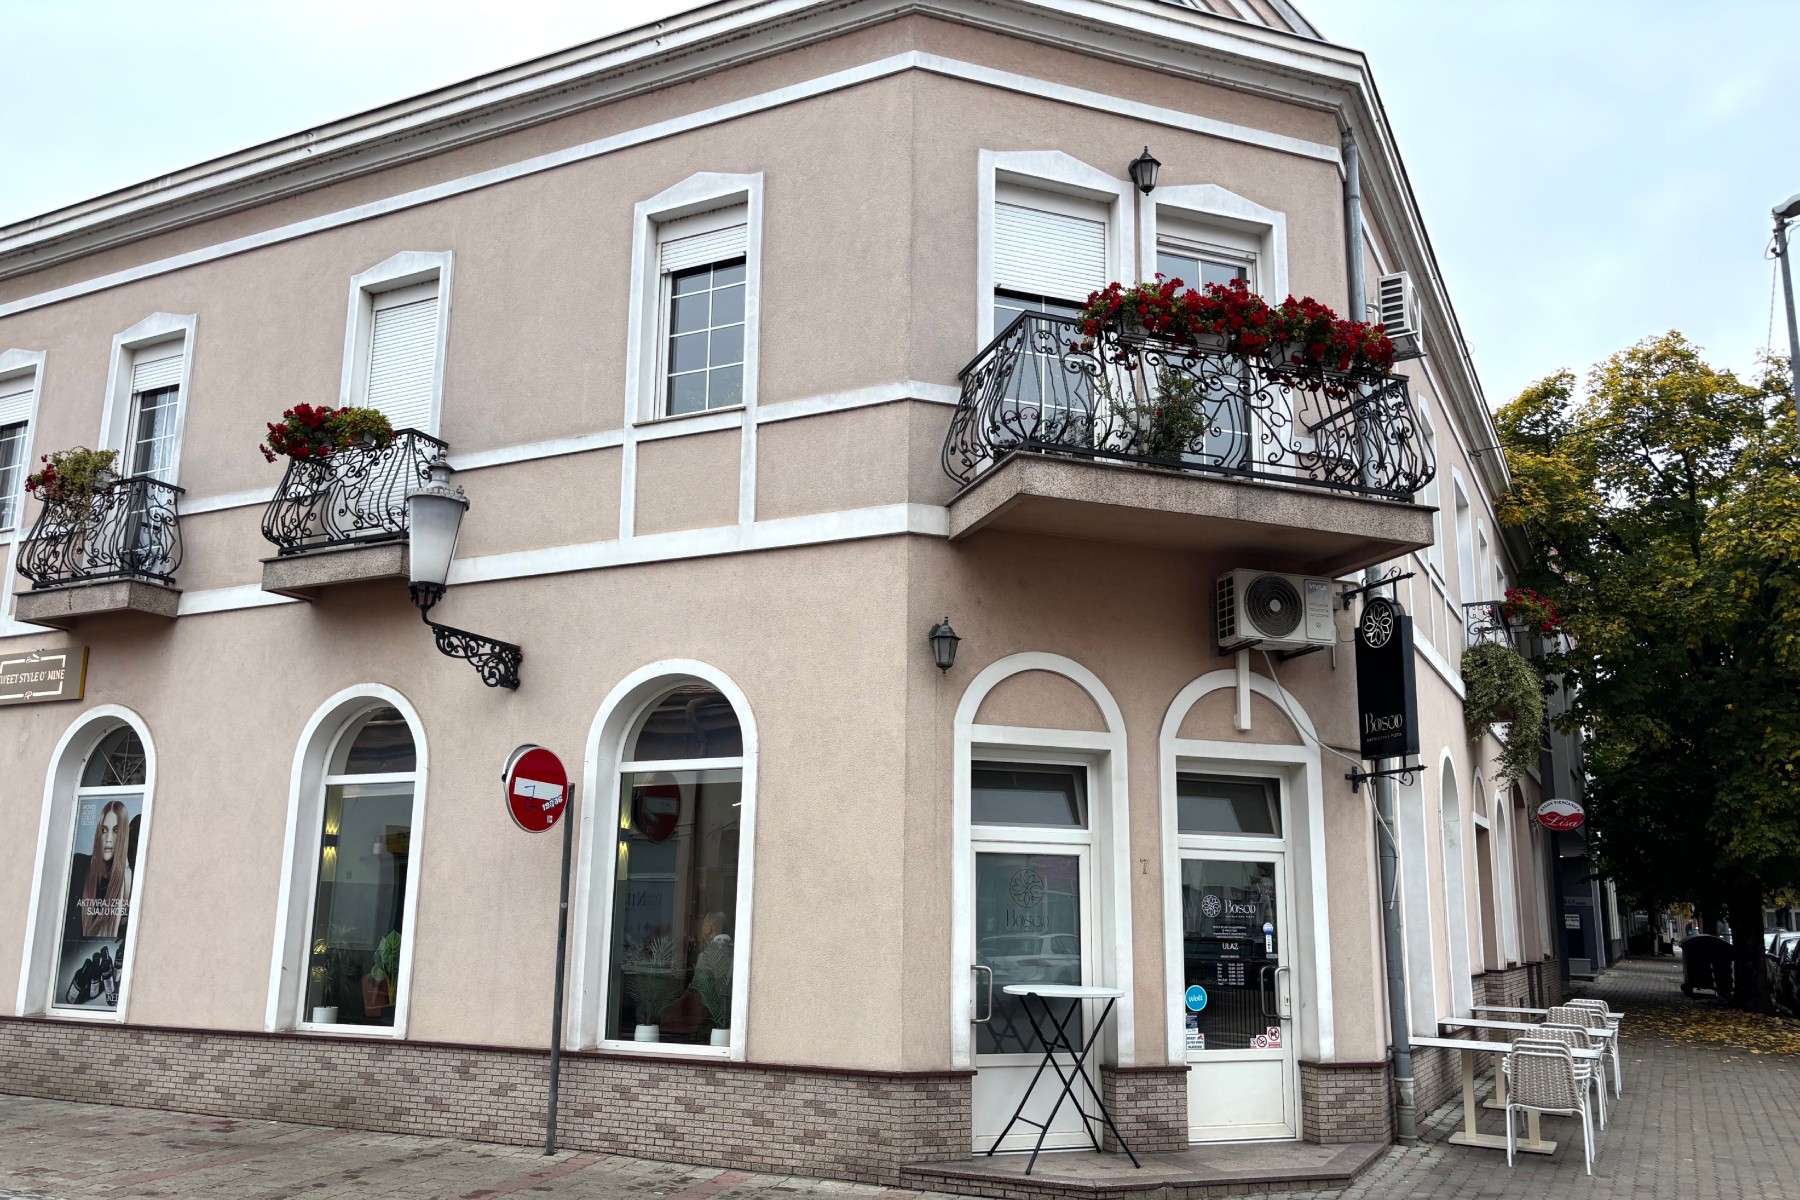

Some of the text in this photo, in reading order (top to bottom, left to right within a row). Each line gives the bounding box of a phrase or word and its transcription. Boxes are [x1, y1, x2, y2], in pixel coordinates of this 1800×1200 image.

[19, 671, 39, 683] STYLE
[47, 669, 65, 681] MINE
[1545, 814, 1578, 827] Lisa
[76, 898, 110, 907] AKTIVIRAJ
[86, 907, 103, 916] SJAJ
[104, 907, 110, 916] U
[1222, 942, 1239, 950] ULAZ
[1188, 994, 1203, 1002] Wolt
